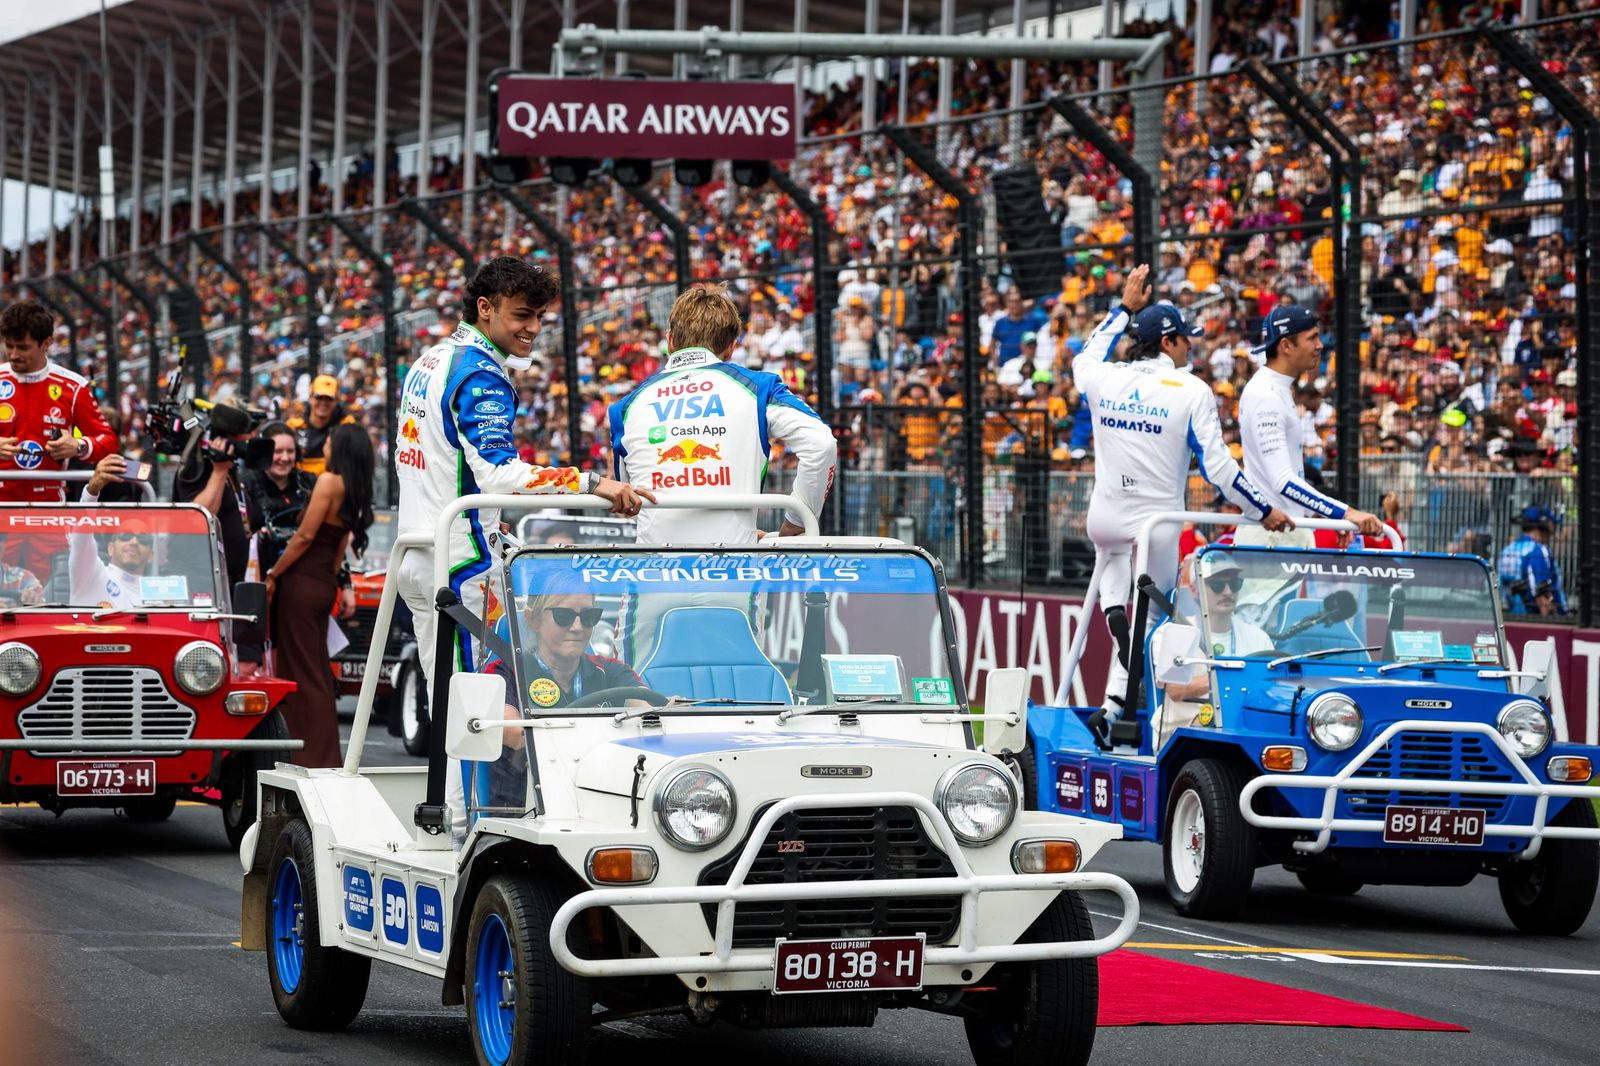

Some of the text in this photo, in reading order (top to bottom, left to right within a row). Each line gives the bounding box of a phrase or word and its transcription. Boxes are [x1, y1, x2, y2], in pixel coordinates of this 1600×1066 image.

[506, 101, 790, 139] QATAR AIRWAYS
[657, 381, 714, 397] HUGO
[647, 394, 725, 422] VISA
[1099, 398, 1169, 418] ATLASSIAN
[671, 424, 727, 436] Cash App
[1100, 416, 1163, 434] KOMATSU
[652, 466, 731, 490] Red Bull
[1285, 486, 1334, 515] KOMATSU
[9, 515, 120, 526] FERRARI
[579, 524, 620, 536] RED
[571, 553, 867, 569] Victorian Mini Club Inc.
[582, 568, 859, 582] RACING BULLS
[1280, 562, 1415, 579] WILLIAMS
[1094, 778, 1107, 807] 55
[777, 840, 805, 852] 1275
[385, 894, 406, 930] 30
[423, 904, 436, 917] LIAM
[421, 918, 440, 934] LAWSON
[830, 941, 871, 950] CLUB PERMIT
[826, 979, 870, 989] VICTORIA
